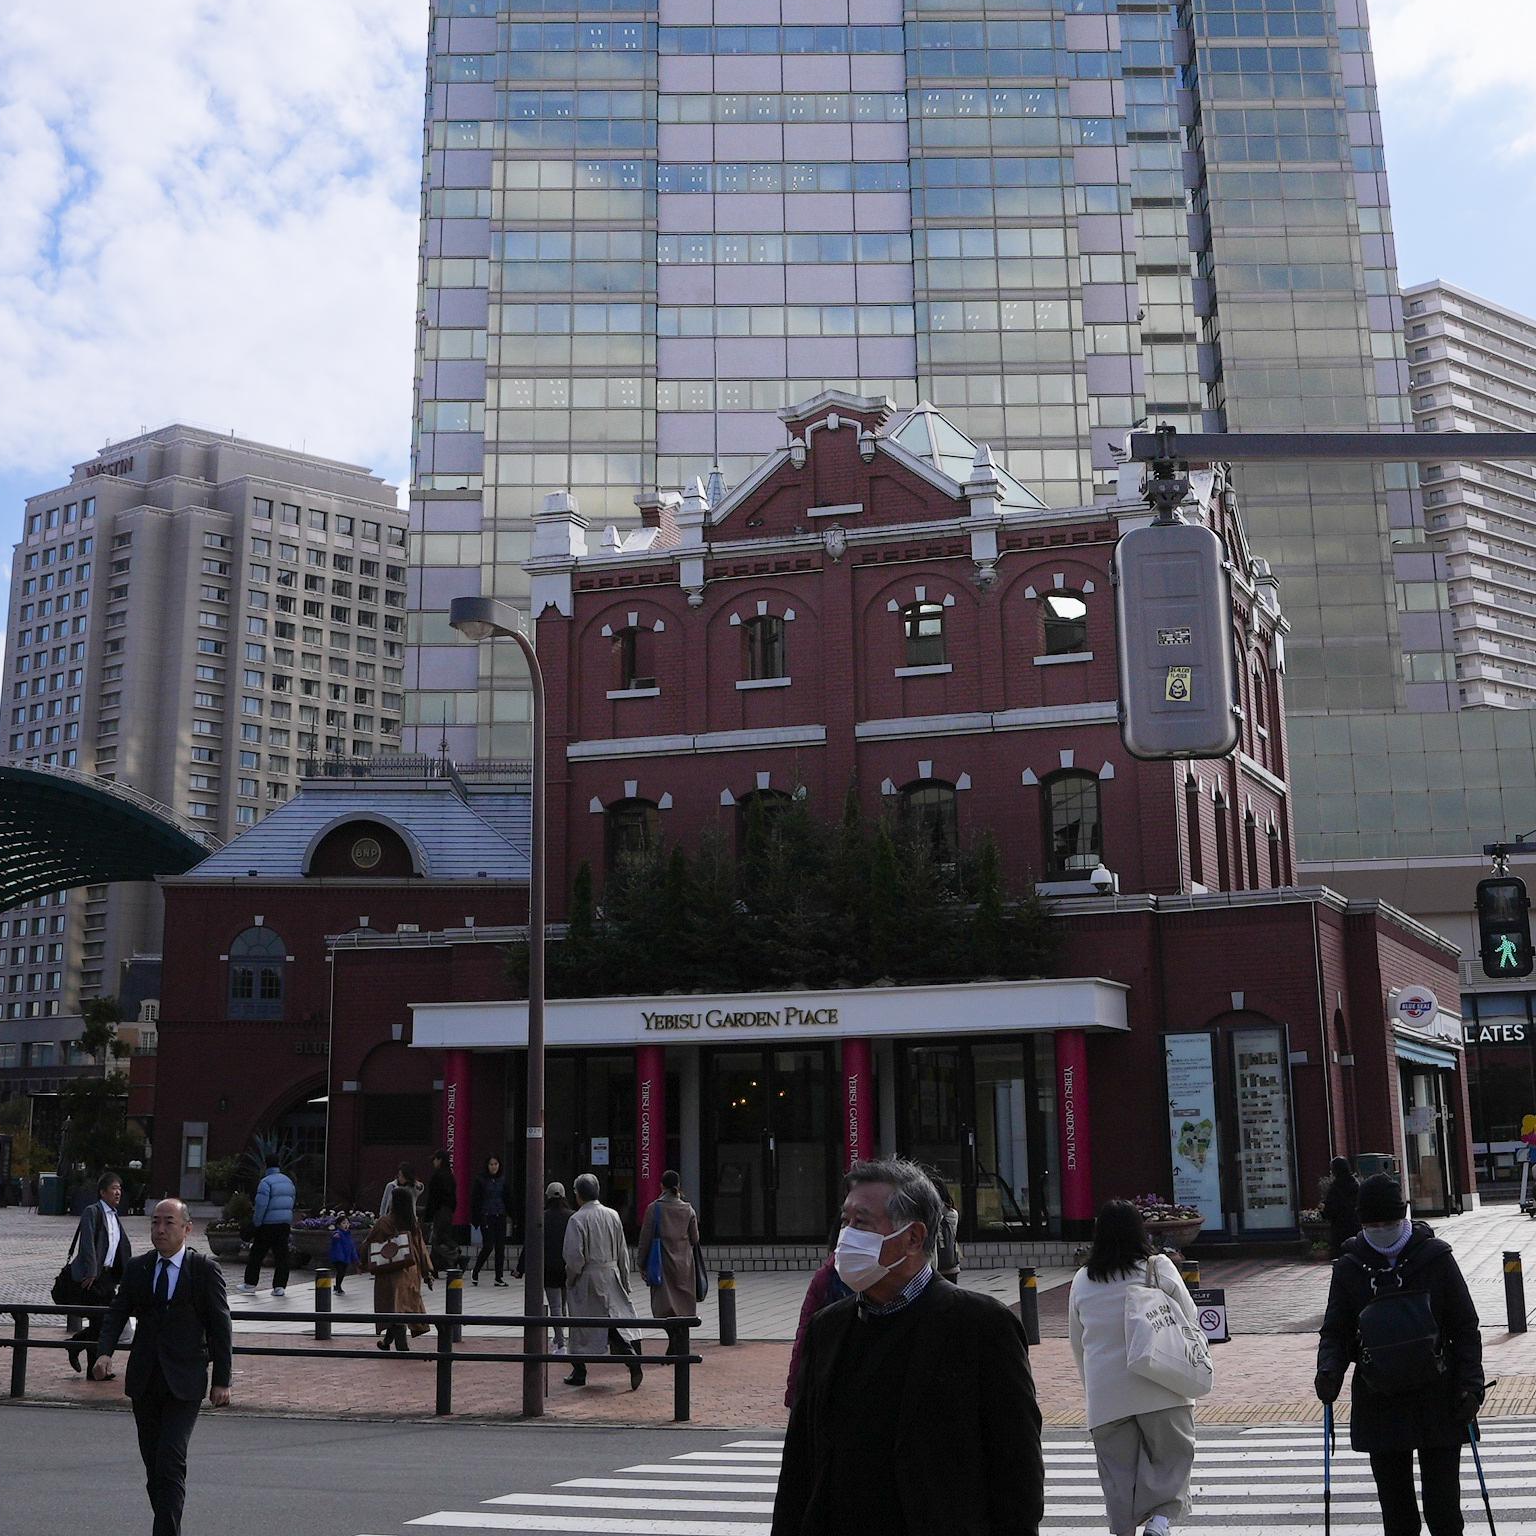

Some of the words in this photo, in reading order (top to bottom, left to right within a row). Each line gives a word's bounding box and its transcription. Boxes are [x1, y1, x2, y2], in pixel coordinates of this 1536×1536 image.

[641, 1012, 702, 1030] YEBISU
[705, 1009, 781, 1028] GARDEN
[784, 1007, 839, 1026] PLACE
[447, 1082, 457, 1113] YEBISU
[641, 1079, 651, 1111] YEBISU
[848, 1074, 858, 1106] YEBISU
[1064, 1065, 1074, 1099] YEBISU
[447, 1114, 457, 1152] GARDEN
[641, 1112, 650, 1152] GARDEN
[849, 1107, 859, 1146] GARDEN
[1064, 1100, 1076, 1141] GARDEN
[1067, 1142, 1076, 1171] PLACE
